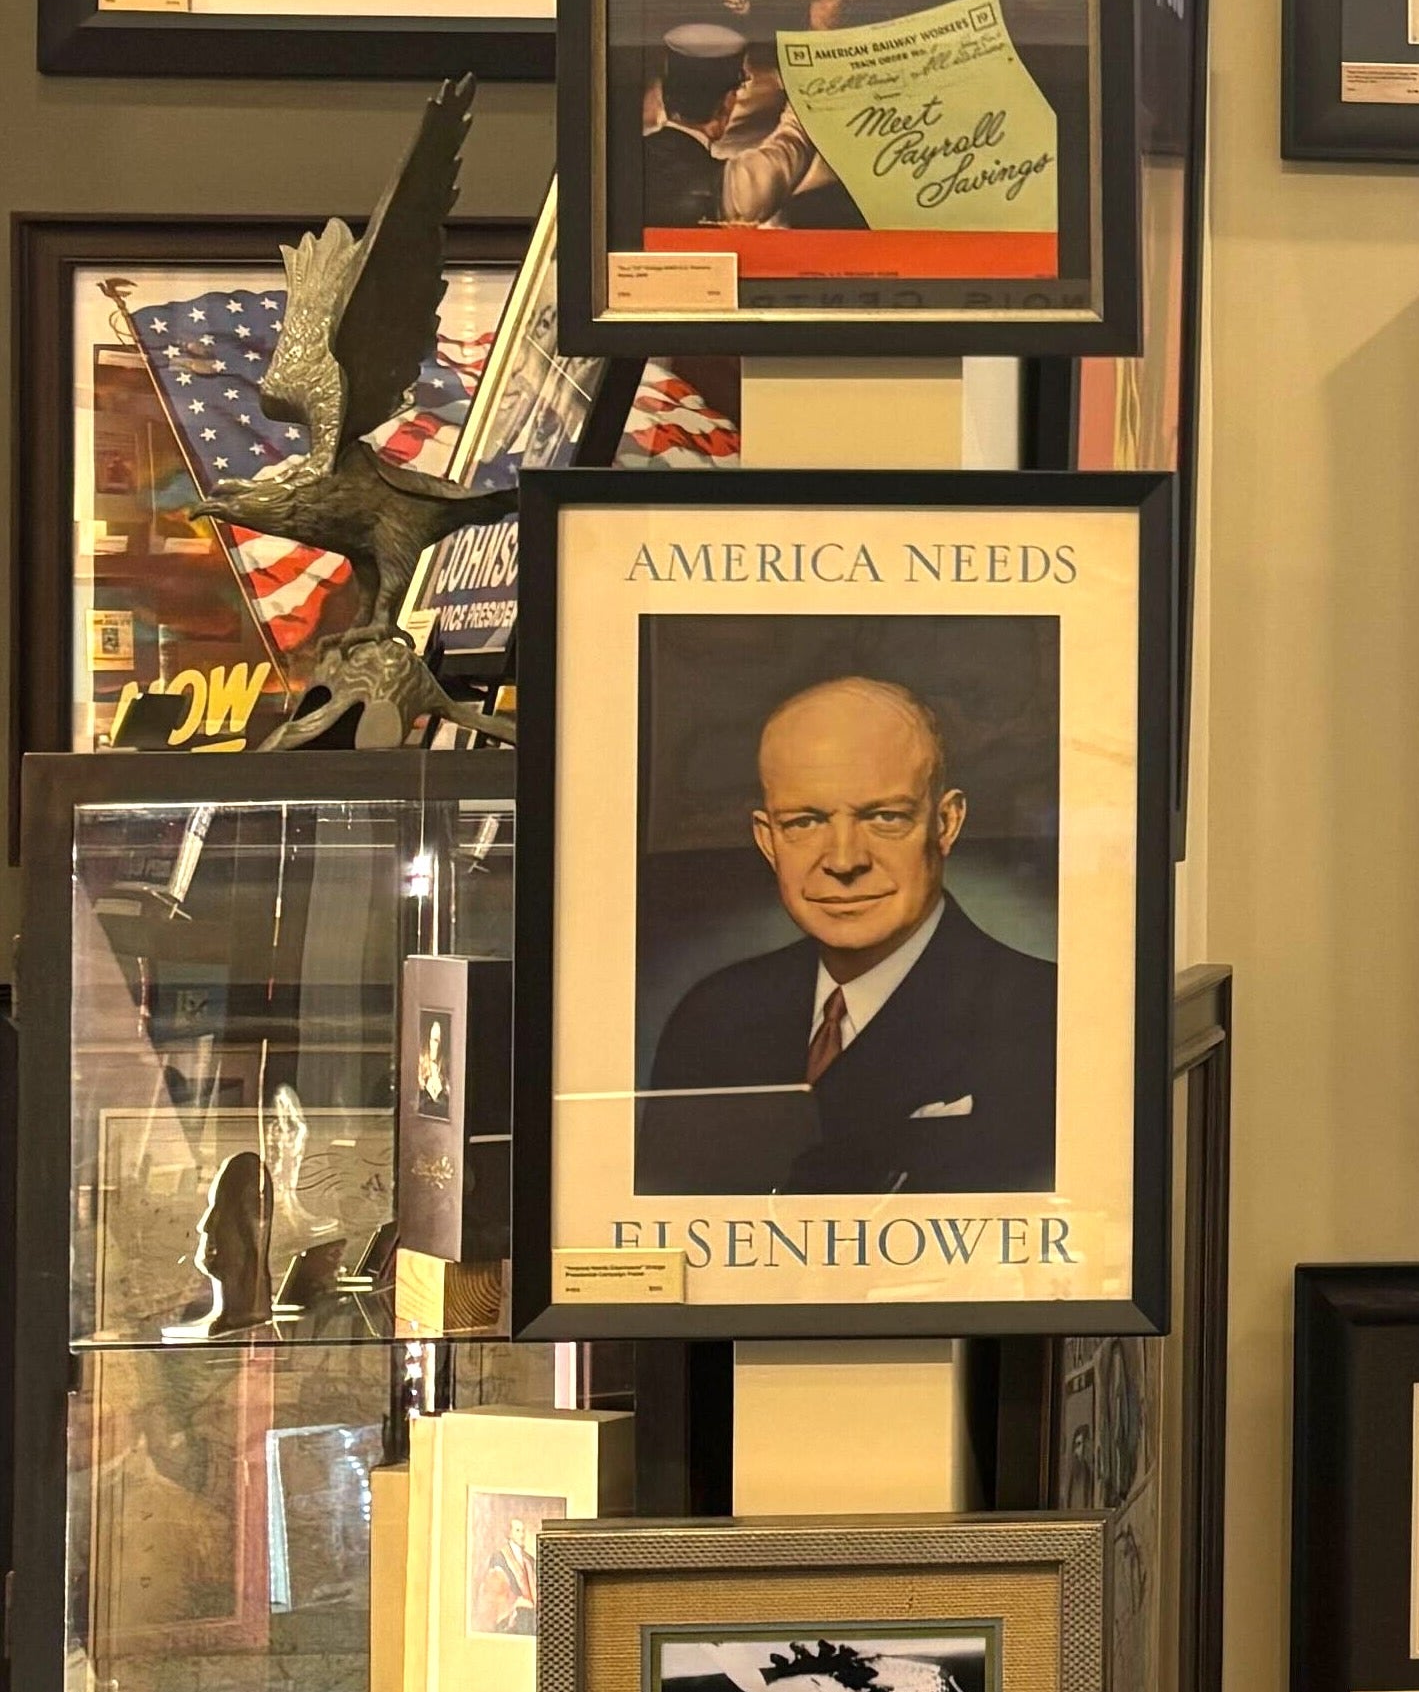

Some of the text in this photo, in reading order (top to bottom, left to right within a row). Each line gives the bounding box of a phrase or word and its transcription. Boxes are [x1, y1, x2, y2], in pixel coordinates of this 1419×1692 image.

[815, 20, 969, 59] AMERICAN RAILWAY WORKERS
[847, 97, 942, 137] Meet
[874, 111, 1007, 177] Payroll
[917, 152, 1054, 208] Savings
[624, 543, 1078, 584] AMERICA NEEDS
[441, 605, 469, 631] VICE
[613, 1218, 1079, 1267] EISENHOWER
